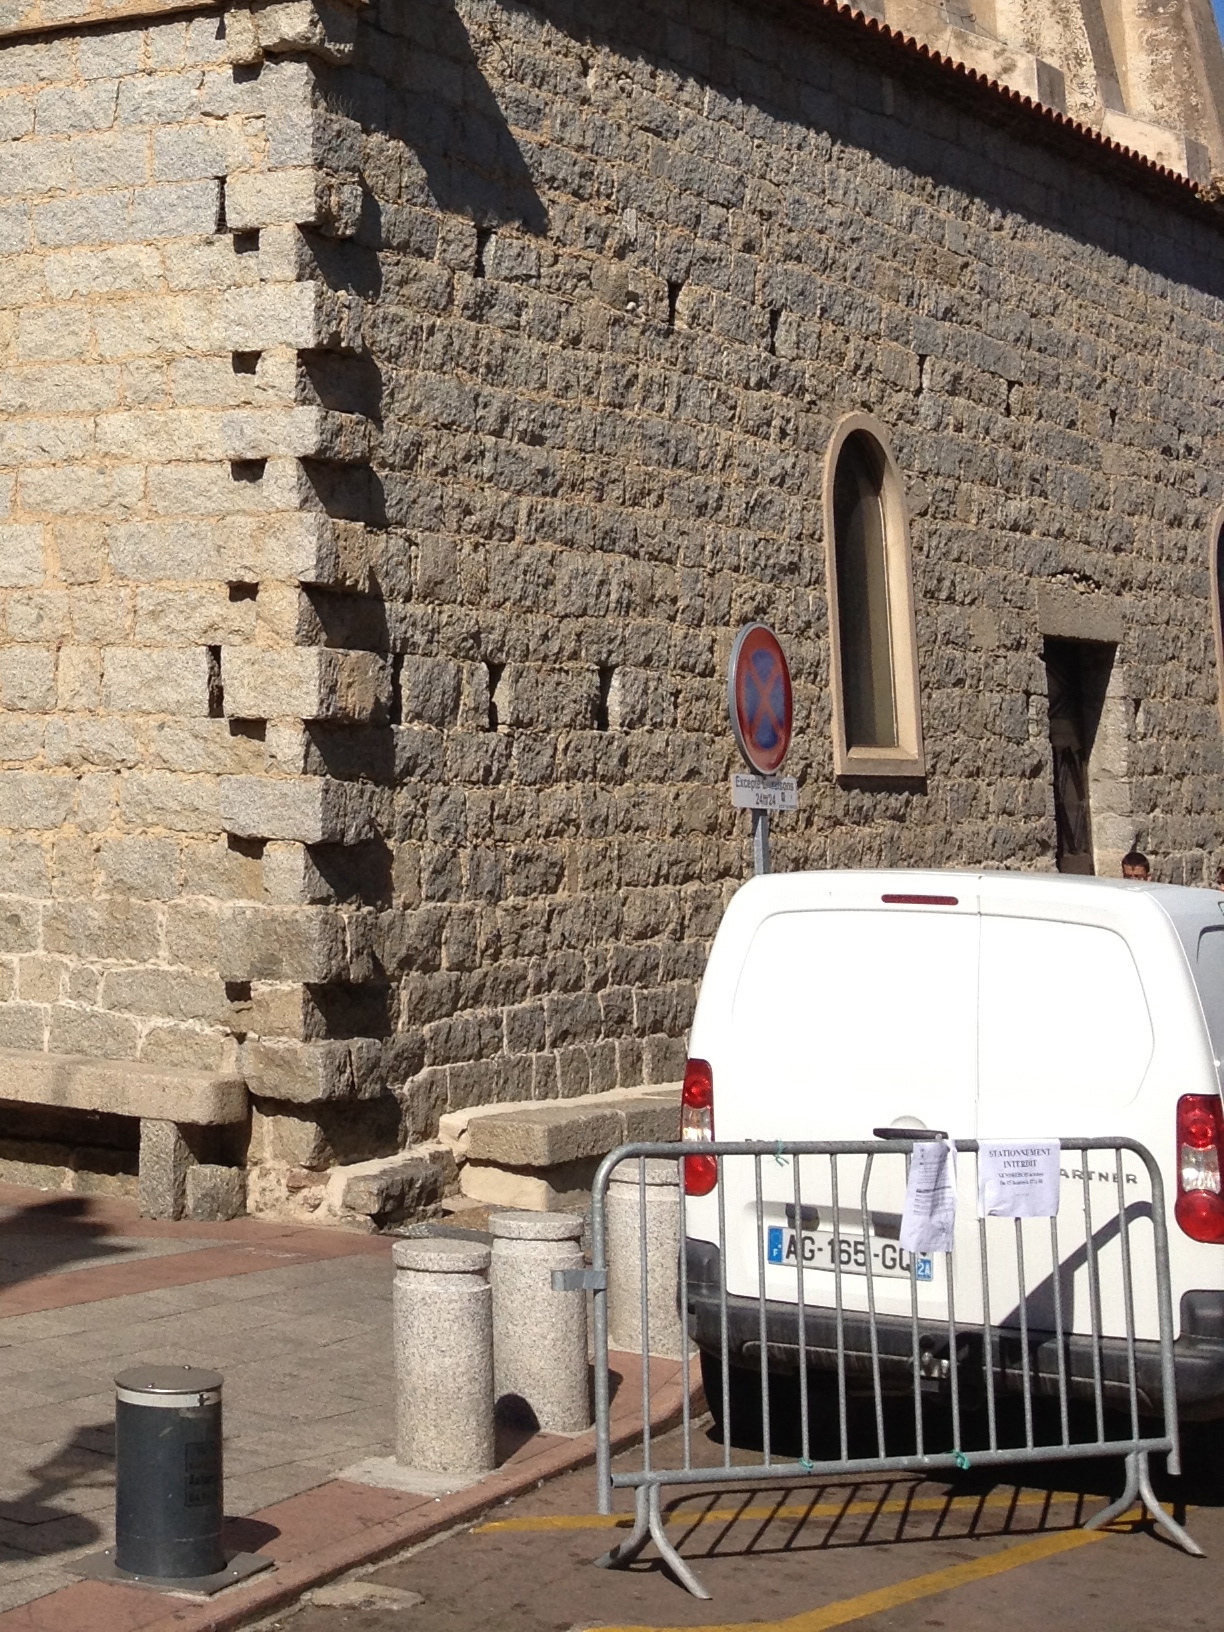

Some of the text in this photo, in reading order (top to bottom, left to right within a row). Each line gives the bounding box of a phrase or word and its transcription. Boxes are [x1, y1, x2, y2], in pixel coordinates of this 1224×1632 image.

[989, 1149, 1051, 1158] STATIONNEMENT
[1004, 1159, 1037, 1168] INTERDIT
[1060, 1168, 1137, 1184] ARTNER
[773, 1248, 779, 1257] F
[918, 1261, 930, 1276] 2A
